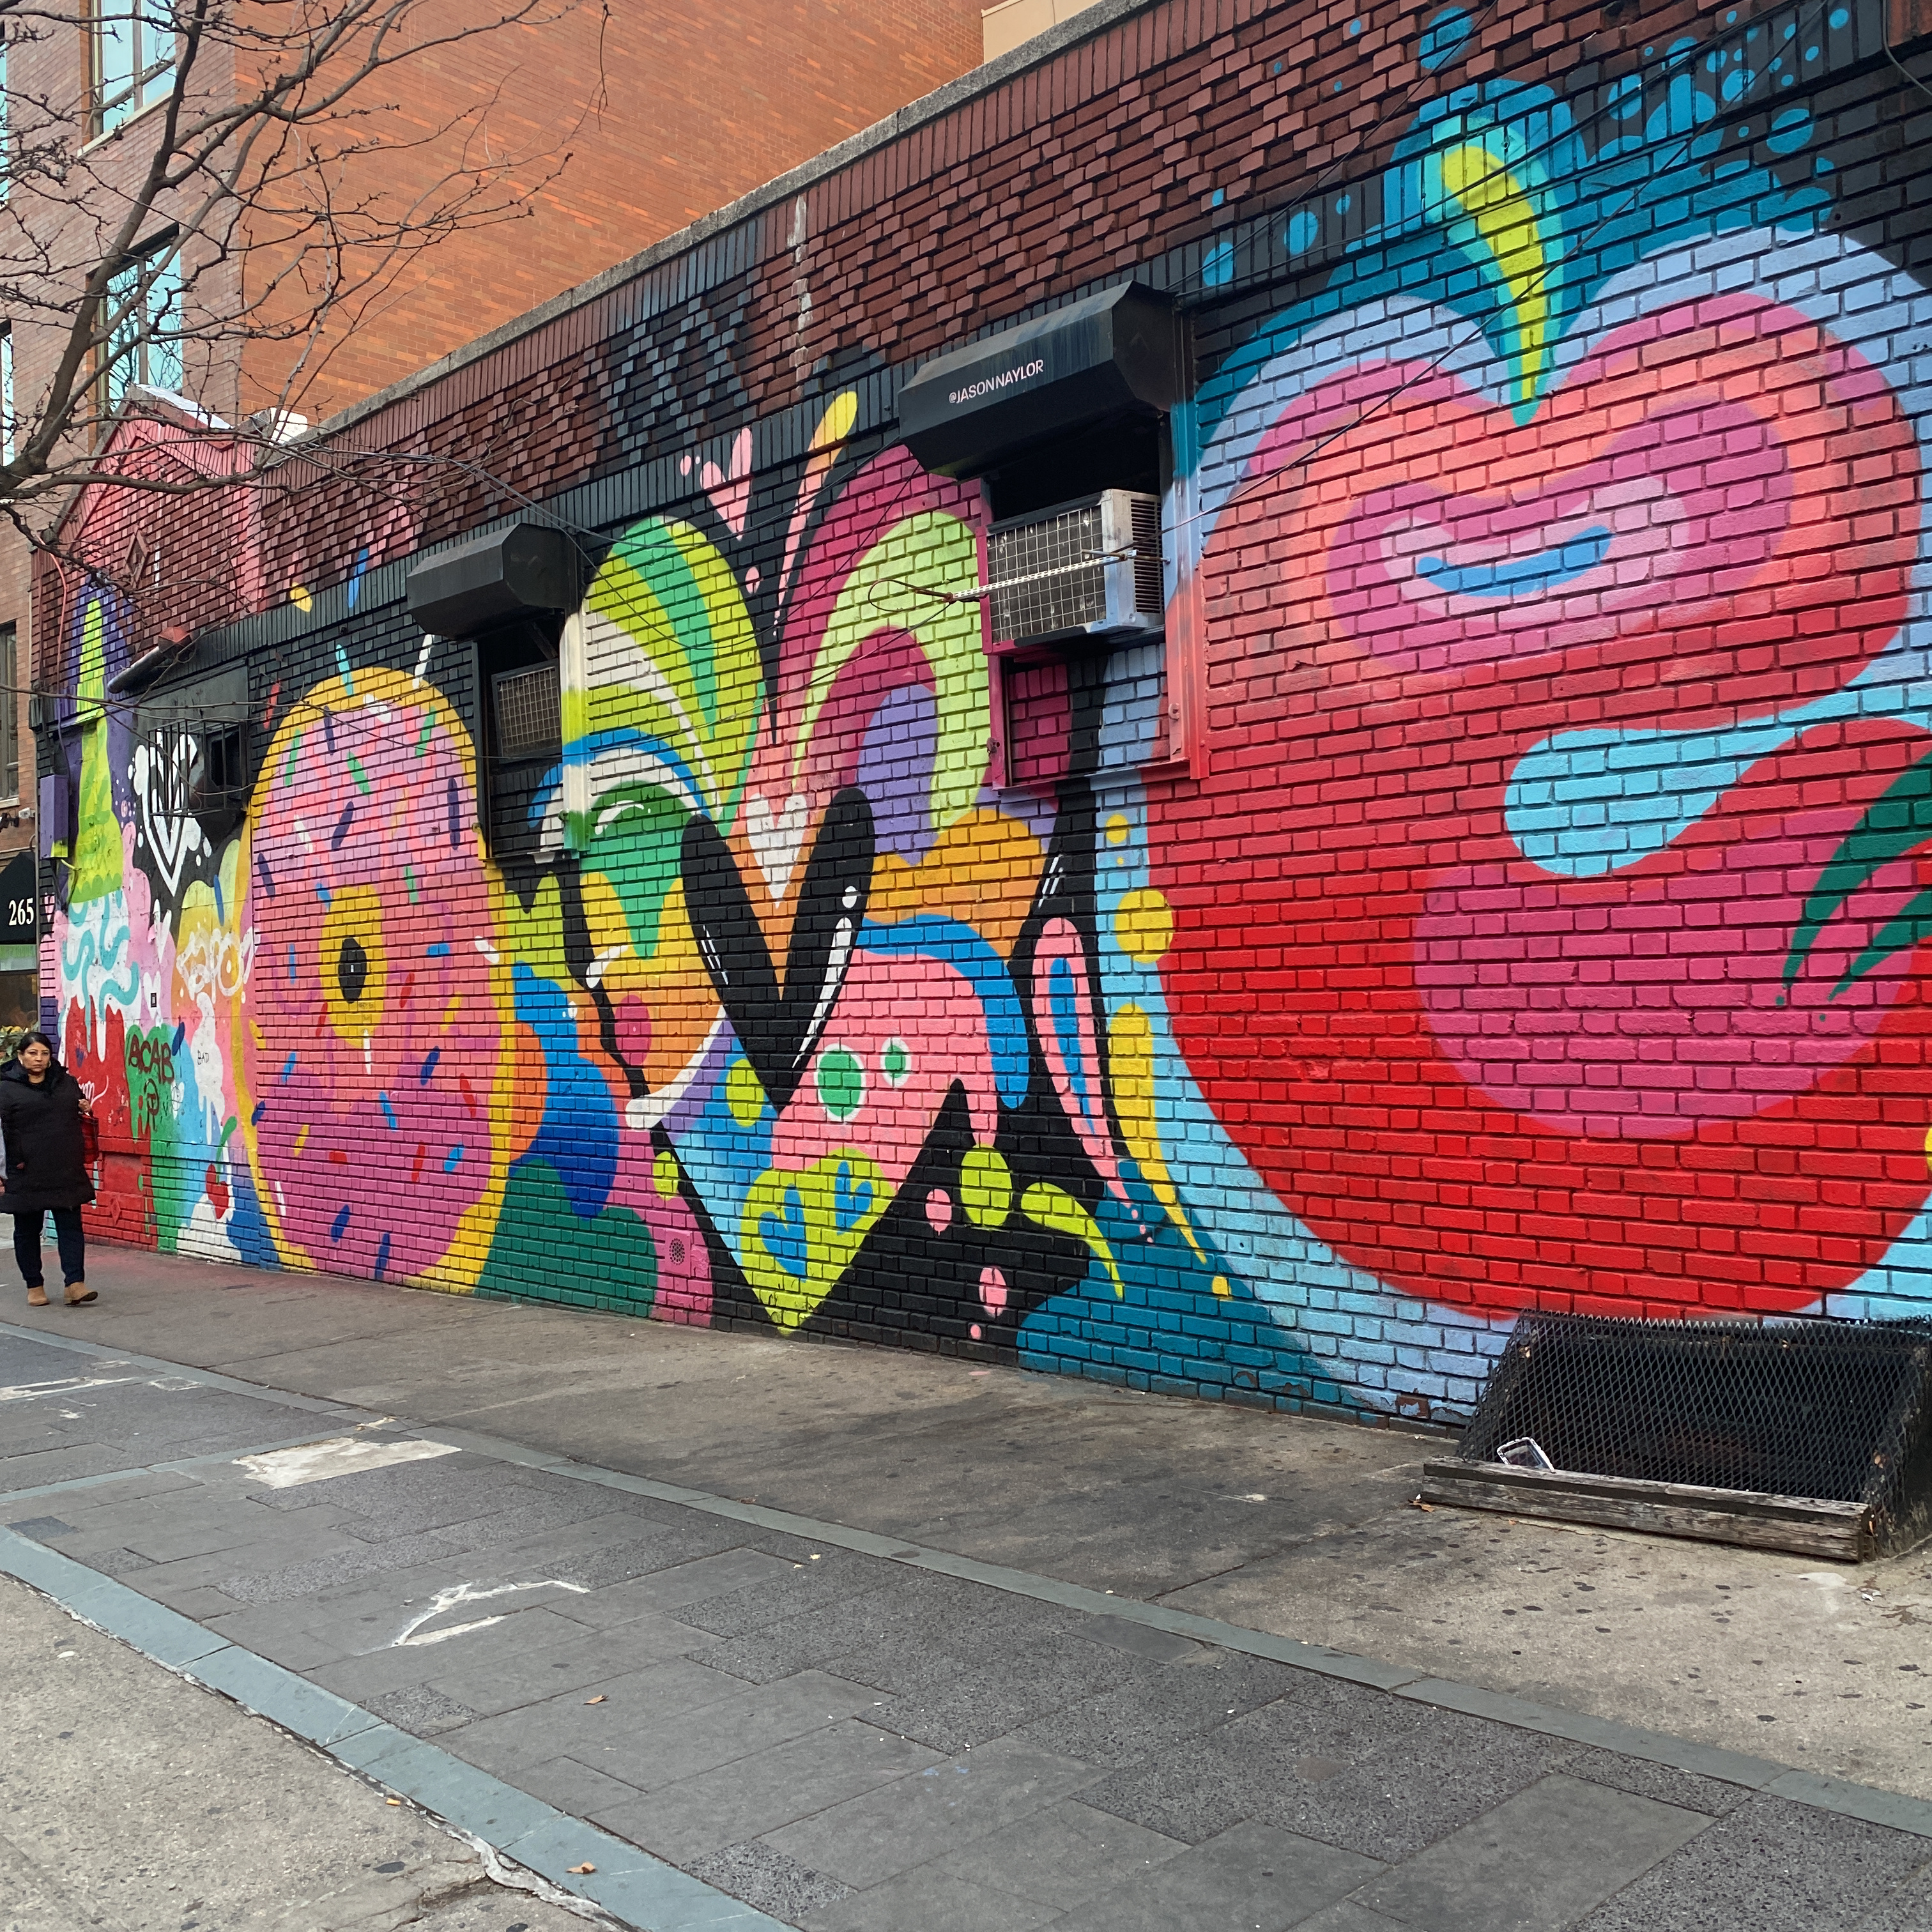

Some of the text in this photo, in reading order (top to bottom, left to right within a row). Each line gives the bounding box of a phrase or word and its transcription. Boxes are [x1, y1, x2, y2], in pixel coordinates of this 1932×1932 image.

[949, 359, 1044, 404] @JASONNAYLOR
[8, 898, 34, 926] 265
[128, 1034, 174, 1085] ACAB
